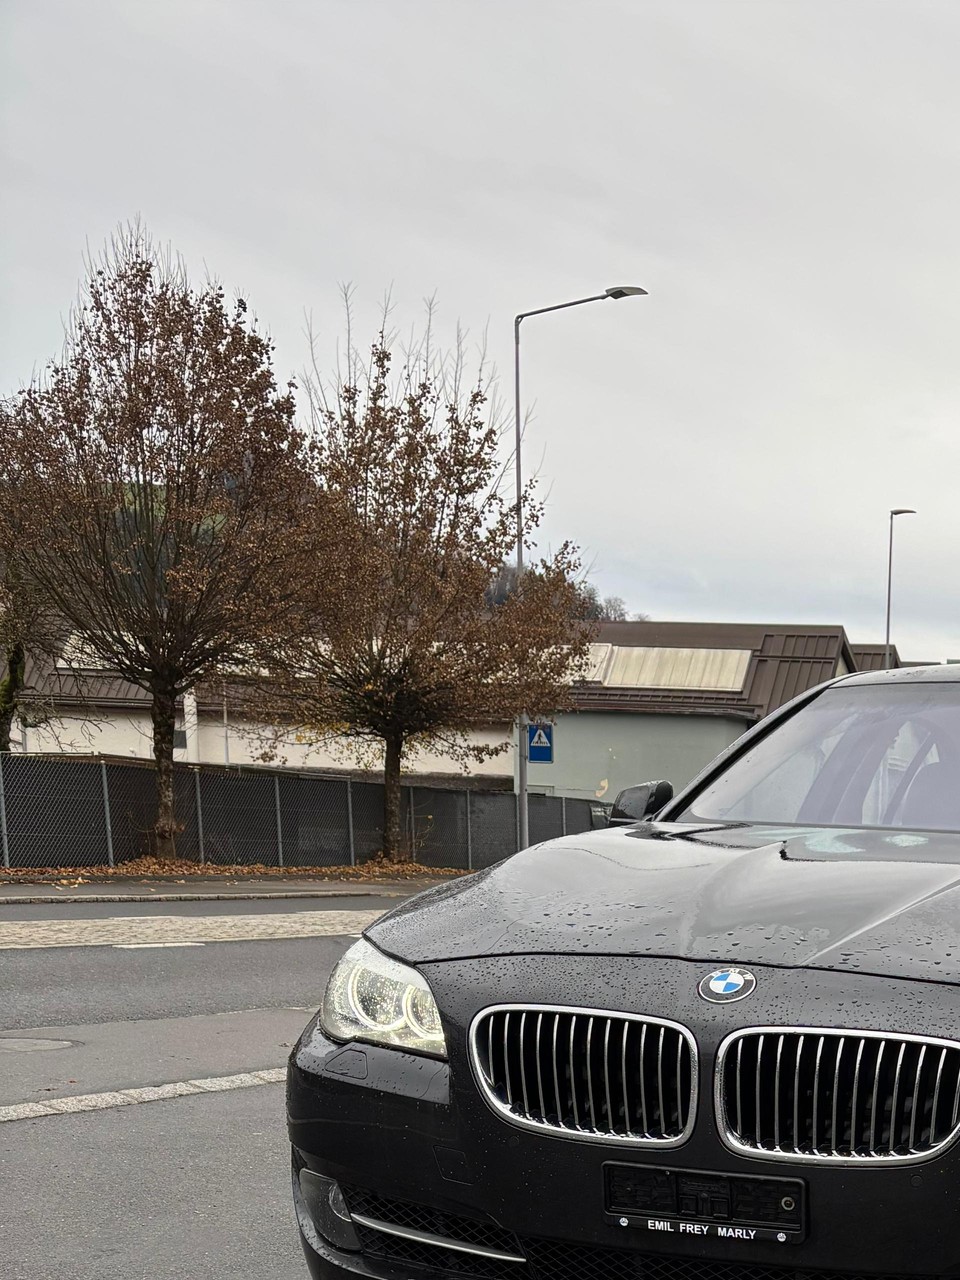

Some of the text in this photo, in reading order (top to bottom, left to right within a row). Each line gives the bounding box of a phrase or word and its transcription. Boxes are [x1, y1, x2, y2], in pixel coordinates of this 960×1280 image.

[647, 1219, 756, 1240] EMIL FREY MARLY
